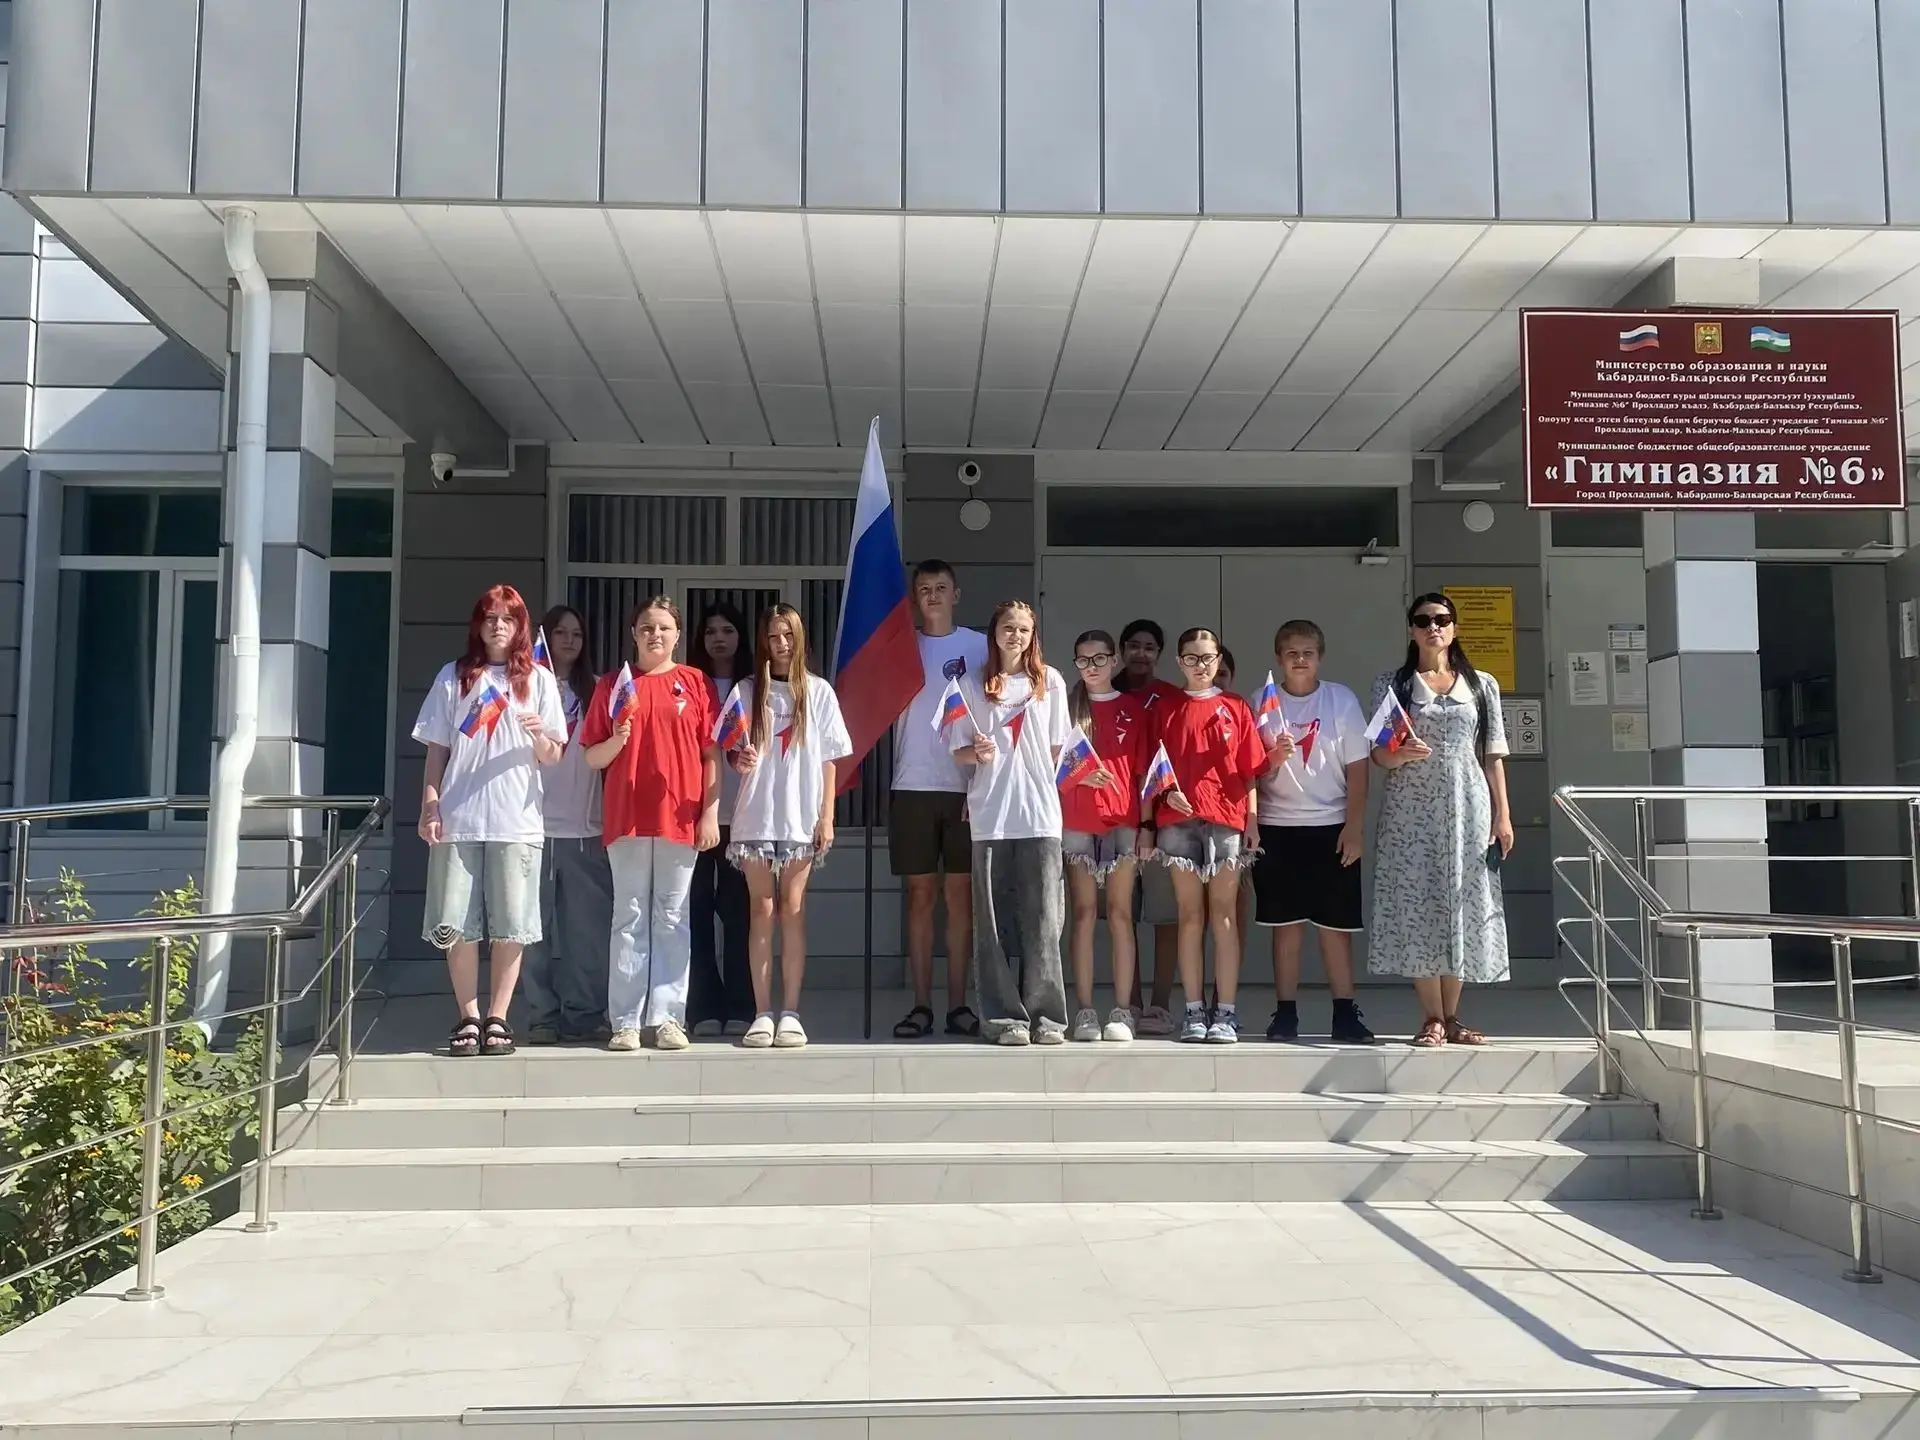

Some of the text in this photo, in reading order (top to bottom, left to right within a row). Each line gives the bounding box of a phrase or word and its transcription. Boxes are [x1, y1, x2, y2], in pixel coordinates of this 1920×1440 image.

[1595, 360, 1828, 372] Министерство образования и науки
[1597, 372, 1827, 384] Кабардино-Балкарской Республики
[1635, 391, 1670, 400] бюджет
[1734, 416, 1770, 424] бюджет
[1557, 442, 1872, 453] Муниципальное бюджетное общеобразовательное учреждение
[1544, 456, 1886, 485] «Гимназия №6»
[1576, 490, 1606, 499] Город
[1676, 490, 1792, 500] Кабардино-Балкарская
